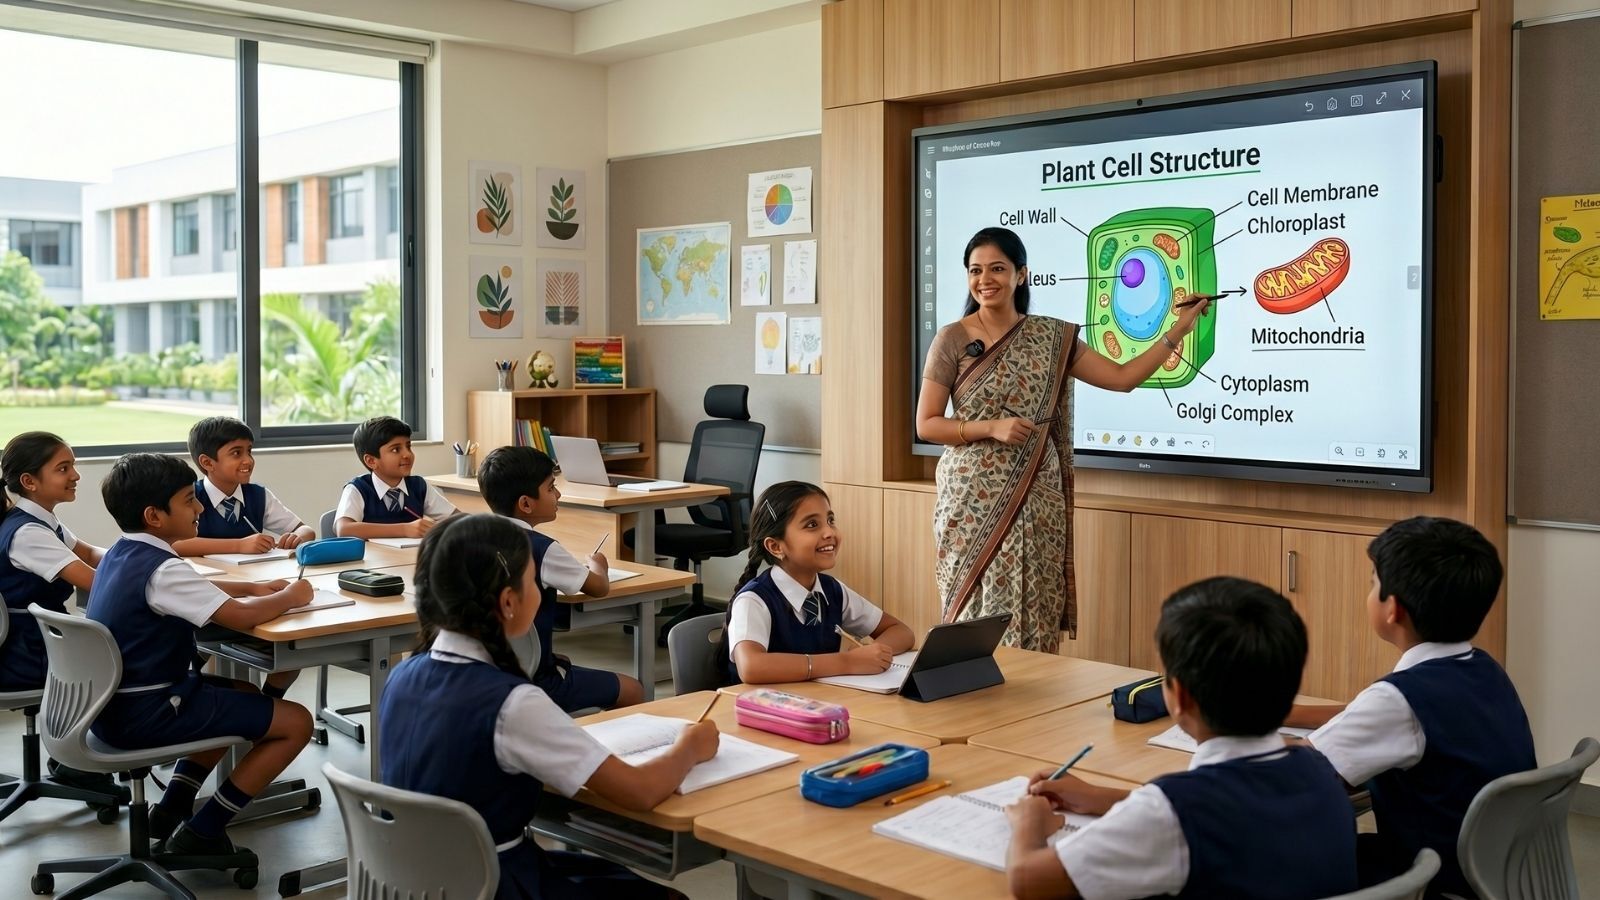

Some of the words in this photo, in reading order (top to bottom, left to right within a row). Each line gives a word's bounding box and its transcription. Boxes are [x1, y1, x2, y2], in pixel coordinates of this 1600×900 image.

[1042, 160, 1096, 184] Plant
[1102, 152, 1143, 179] Cell
[1149, 146, 1261, 175] Structure
[1247, 187, 1278, 207] Cell
[1284, 182, 1379, 204] Membrane
[999, 209, 1024, 226] Cell
[1028, 207, 1056, 224] Wall
[1247, 212, 1346, 235] Chloroplast
[1028, 271, 1057, 287] leus
[1251, 326, 1365, 345] Mitochondria
[1220, 374, 1309, 396] Cytoplasm
[1176, 402, 1217, 424] Golgi
[1221, 404, 1294, 426] Complex
